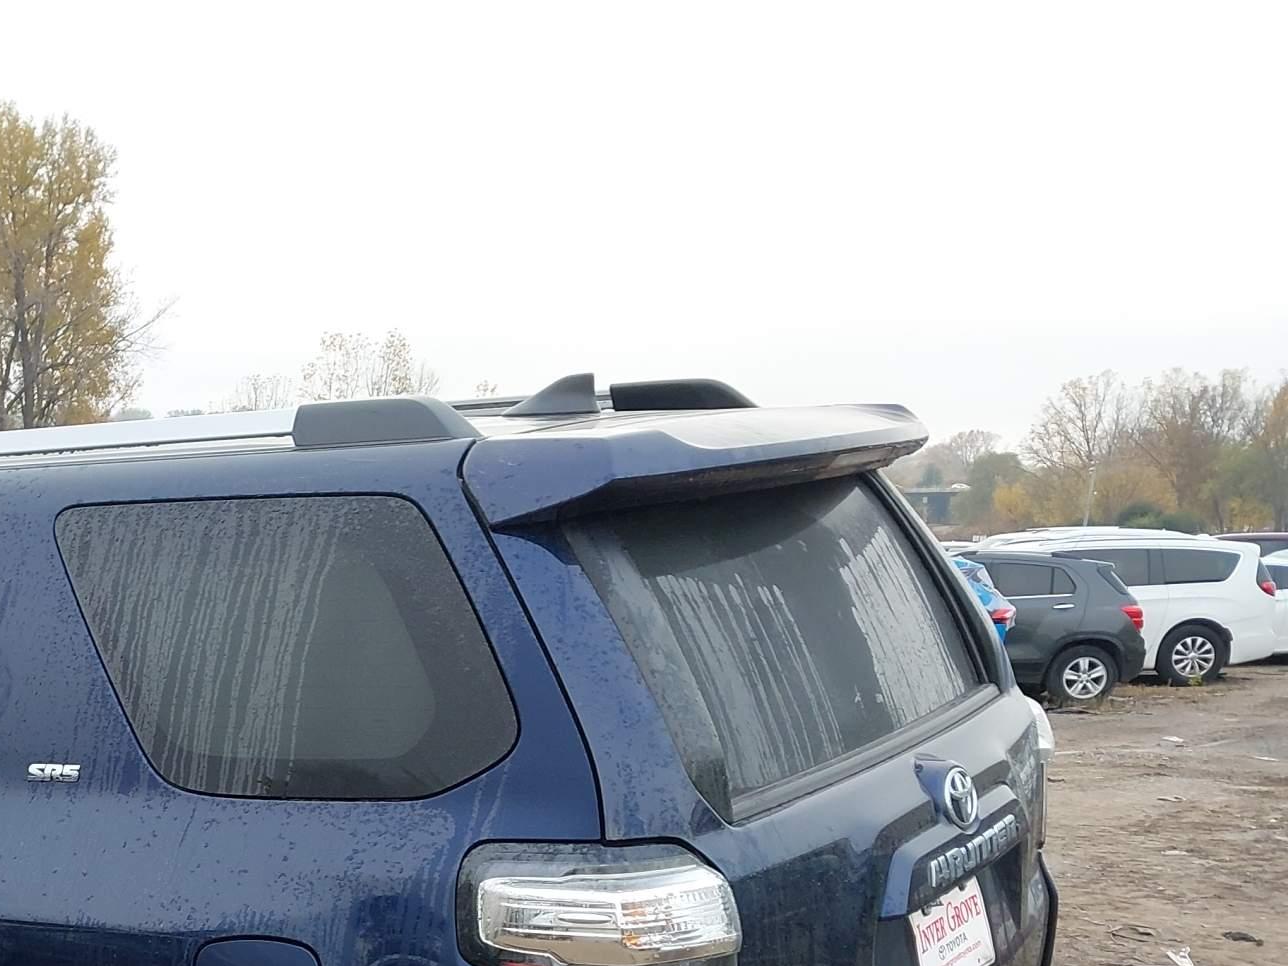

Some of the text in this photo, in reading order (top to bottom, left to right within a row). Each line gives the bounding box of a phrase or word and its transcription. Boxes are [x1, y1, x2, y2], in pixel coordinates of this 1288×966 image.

[27, 763, 81, 781] SR5
[916, 894, 981, 955] INVER GROVE
[946, 932, 969, 953] TOYOTA
